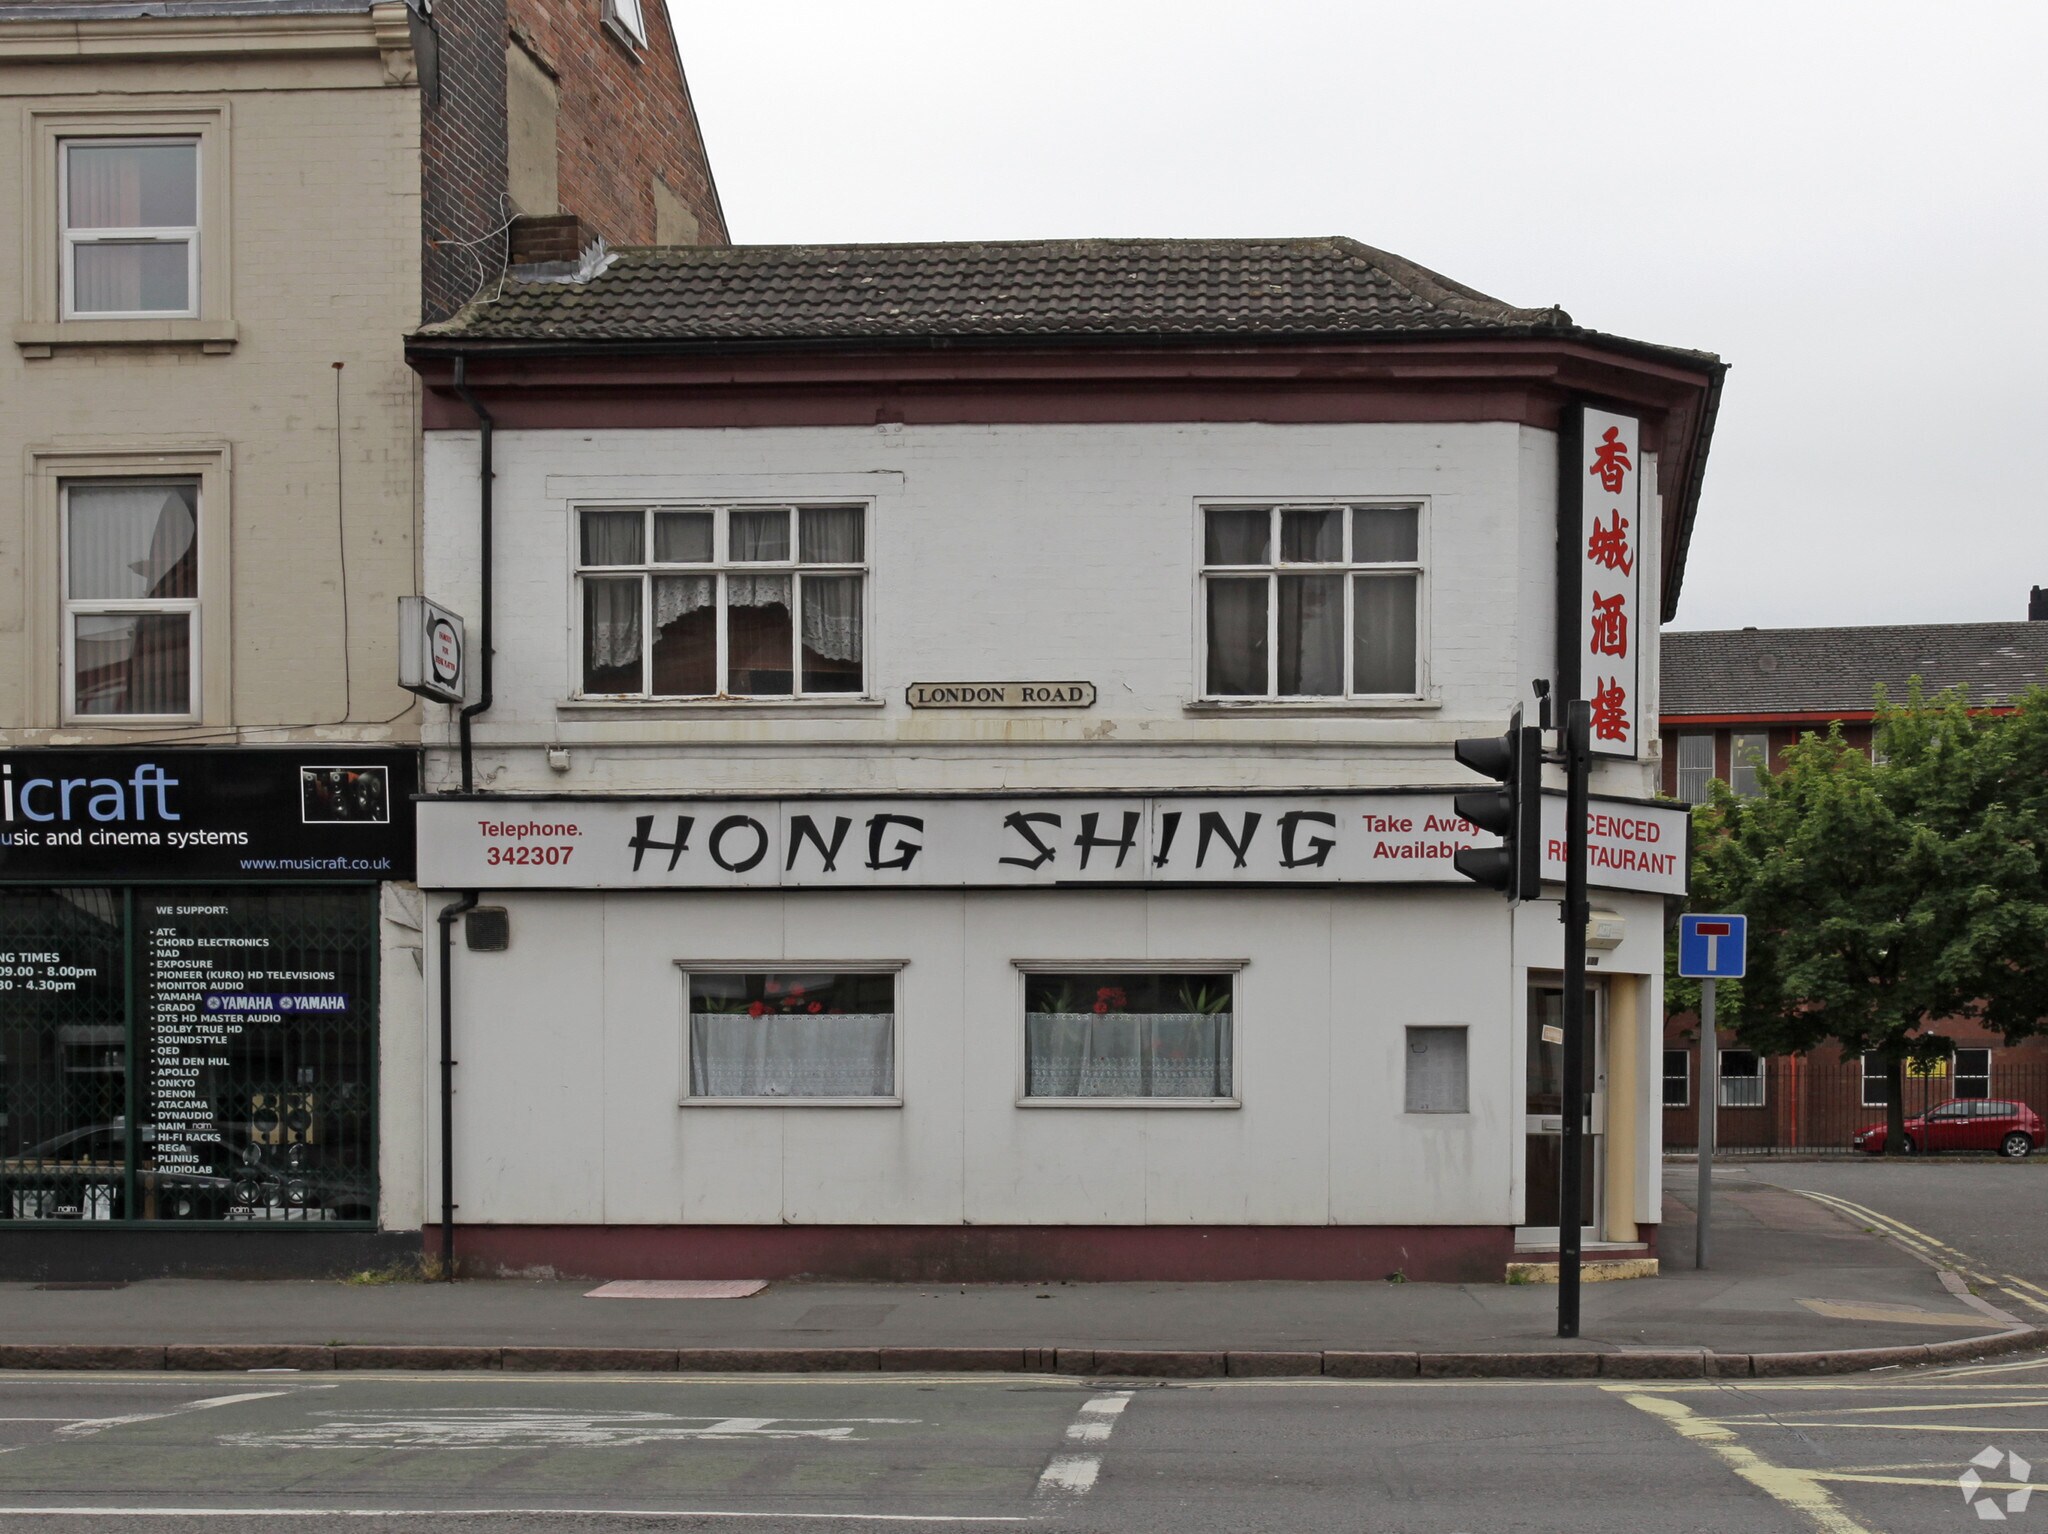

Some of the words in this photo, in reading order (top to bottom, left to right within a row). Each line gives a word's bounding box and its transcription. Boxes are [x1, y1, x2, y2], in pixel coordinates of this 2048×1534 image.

[1588, 426, 1634, 742] 香城酒樓
[918, 687, 1005, 703] LONDON
[1022, 686, 1083, 702] ROAD
[478, 820, 583, 839] Telephone.
[1363, 815, 1412, 833] Take
[1423, 814, 1480, 836] Away
[1566, 812, 1661, 844] CENCED
[46, 828, 82, 846] and
[89, 828, 161, 845] cinema
[167, 829, 249, 849] systems
[628, 813, 924, 873] HONG
[999, 810, 1336, 870] SHING
[487, 846, 574, 866] 342307
[1548, 839, 1677, 876] RETAURANT
[240, 856, 390, 870] www.musicraft.co.uk
[156, 906, 173, 915] WE
[176, 905, 229, 915] SUPPORT:
[156, 927, 177, 937] ATC
[156, 938, 195, 947] CHORD
[197, 938, 270, 947] ELECTRONICS
[18, 952, 60, 963] TIMES
[156, 949, 180, 958] NAD
[156, 960, 213, 969] EXPOSURE
[47, 966, 97, 979] 8.00pm
[156, 970, 203, 979] PIONEER
[206, 970, 245, 980] (KURO)
[247, 971, 264, 979] HD
[266, 971, 335, 980] TELEVISIONS
[25, 980, 76, 993] 4.30pm
[156, 981, 207, 990] MONITOR
[209, 981, 244, 990] AUDIO
[157, 992, 203, 1001] YAMAHA
[157, 1003, 196, 1012] GRADO
[221, 996, 274, 1010] YAMAHA
[293, 996, 346, 1010] YAMAHA
[157, 1014, 179, 1023] DTS
[181, 1014, 198, 1023] HD
[200, 1014, 244, 1023] MASTER
[246, 1014, 281, 1023] AUDIO
[157, 1024, 193, 1034] DOLBY
[195, 1024, 224, 1034] TRUE
[226, 1025, 243, 1034] HD
[157, 1035, 228, 1044] SOUNDSTYLE
[157, 1046, 180, 1056] QED
[157, 1057, 180, 1066] VAN
[182, 1057, 205, 1066] DEN
[208, 1057, 230, 1066] HUL
[157, 1068, 200, 1077] APOLLO
[157, 1079, 196, 1088] ONKYO
[157, 1089, 196, 1098] DENON
[157, 1100, 208, 1109] ATACAMA
[158, 1111, 214, 1120] DYNAUDIO
[157, 1122, 186, 1131] NAIM
[158, 1133, 183, 1142] HI-FI
[185, 1133, 222, 1142] RACKS
[157, 1143, 187, 1153] REGA
[157, 1154, 200, 1164] PLINIUS
[157, 1165, 213, 1176] AUDIOLAB
